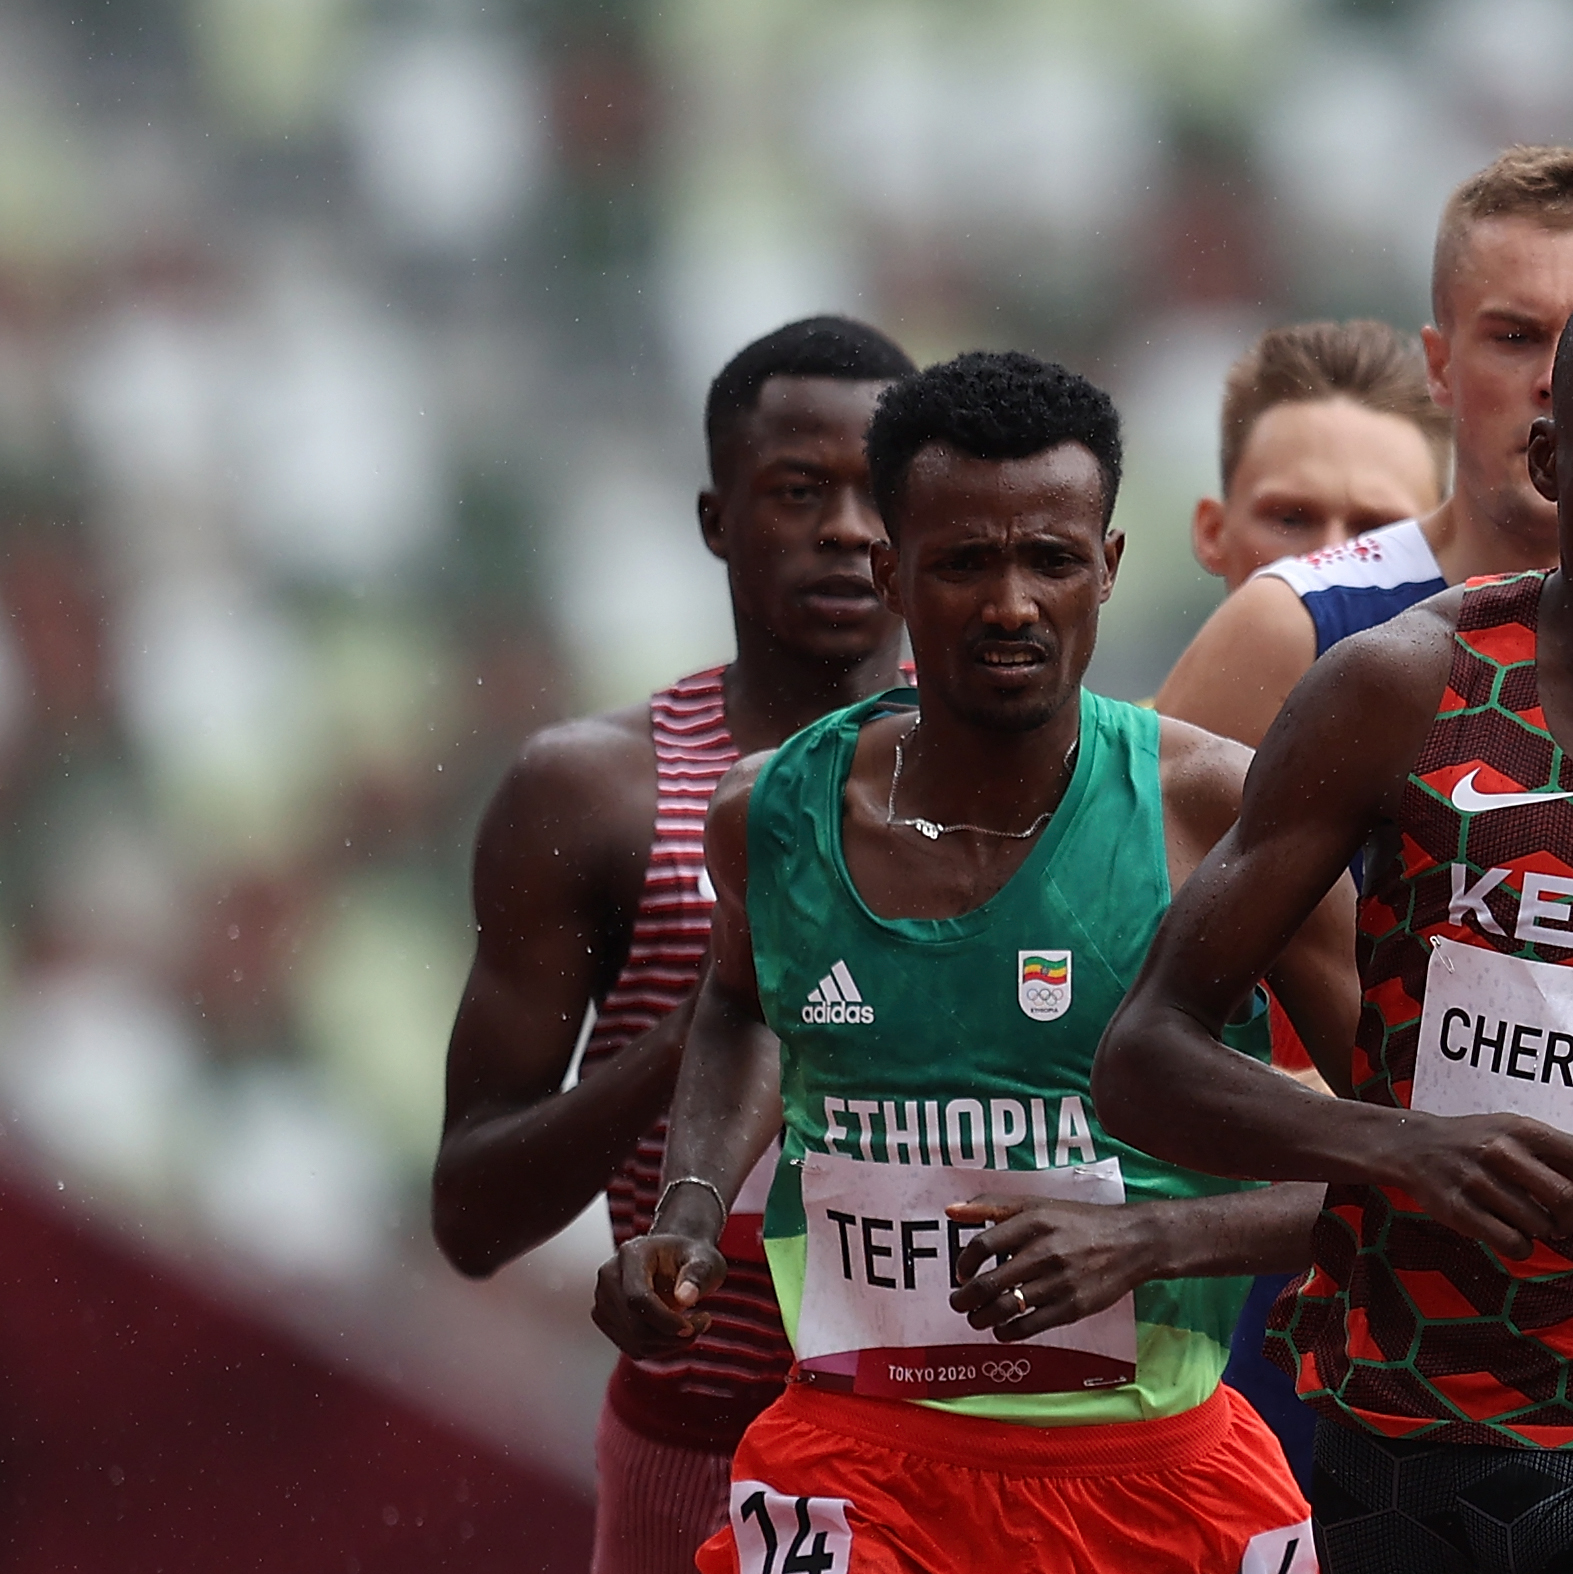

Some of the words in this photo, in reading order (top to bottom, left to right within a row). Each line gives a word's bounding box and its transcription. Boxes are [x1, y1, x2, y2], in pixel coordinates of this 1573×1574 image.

[802, 1001, 875, 1024] adidas
[824, 1096, 1097, 1170] ETHIOPIA
[826, 1208, 1006, 1290] TEFE
[888, 1364, 934, 1383] TOKYO
[938, 1365, 977, 1382] 2020
